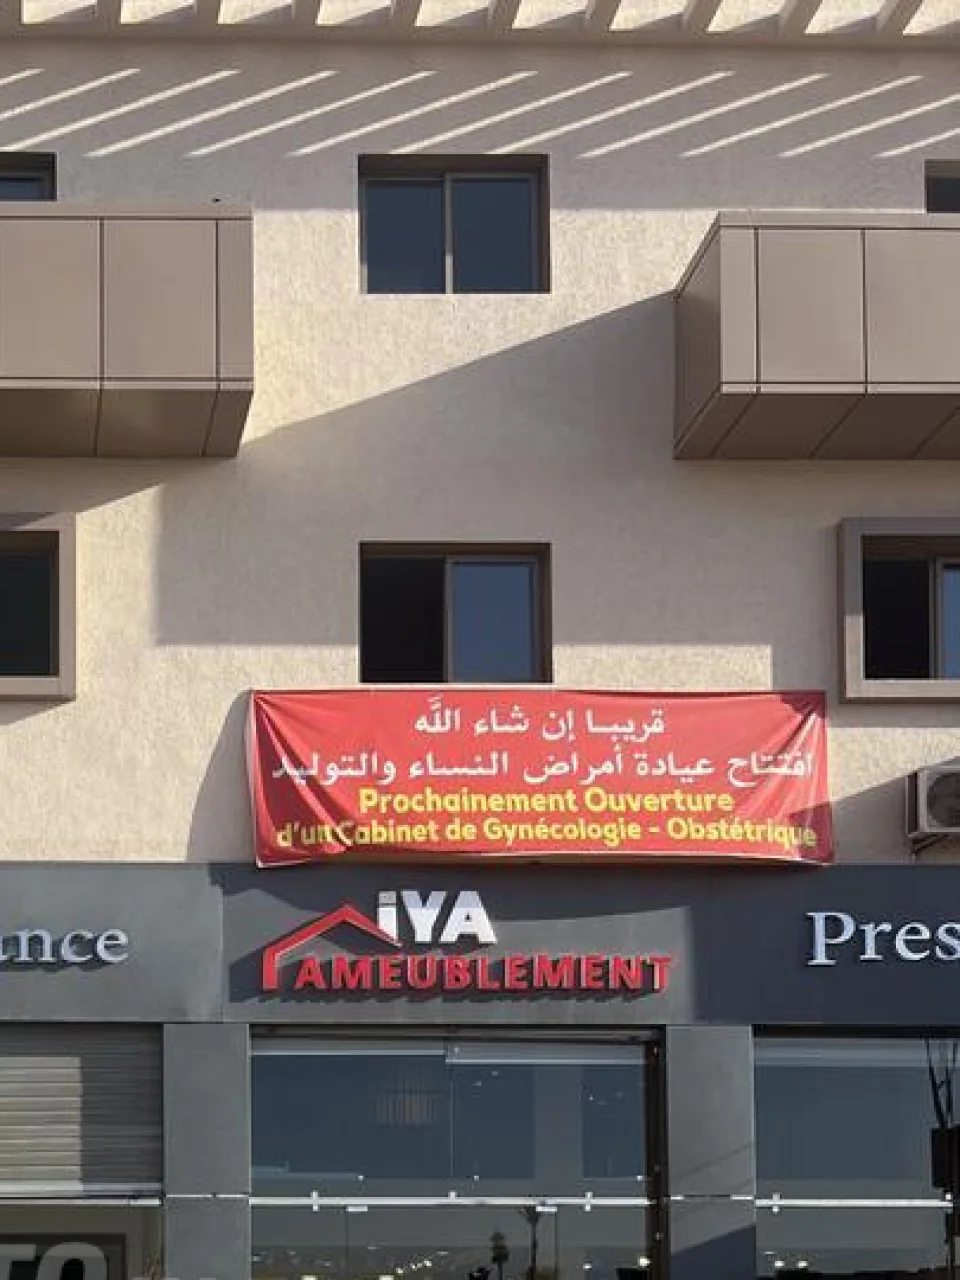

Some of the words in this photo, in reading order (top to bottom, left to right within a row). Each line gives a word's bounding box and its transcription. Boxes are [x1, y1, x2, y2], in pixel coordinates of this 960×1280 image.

[473, 704, 528, 736] شاء
[541, 709, 575, 741] إن
[584, 709, 665, 743] قريبا
[408, 751, 508, 777] النساء
[523, 744, 624, 786] أمراض
[632, 751, 714, 783] عيادة
[358, 786, 579, 814] Prochainement
[584, 786, 735, 813] Ouverture
[445, 817, 477, 842] de
[483, 817, 642, 847] Gynécologie
[666, 817, 818, 848] Obstétrique
[806, 911, 960, 965] Pres
[294, 952, 673, 992] AMEUBLEMENT
